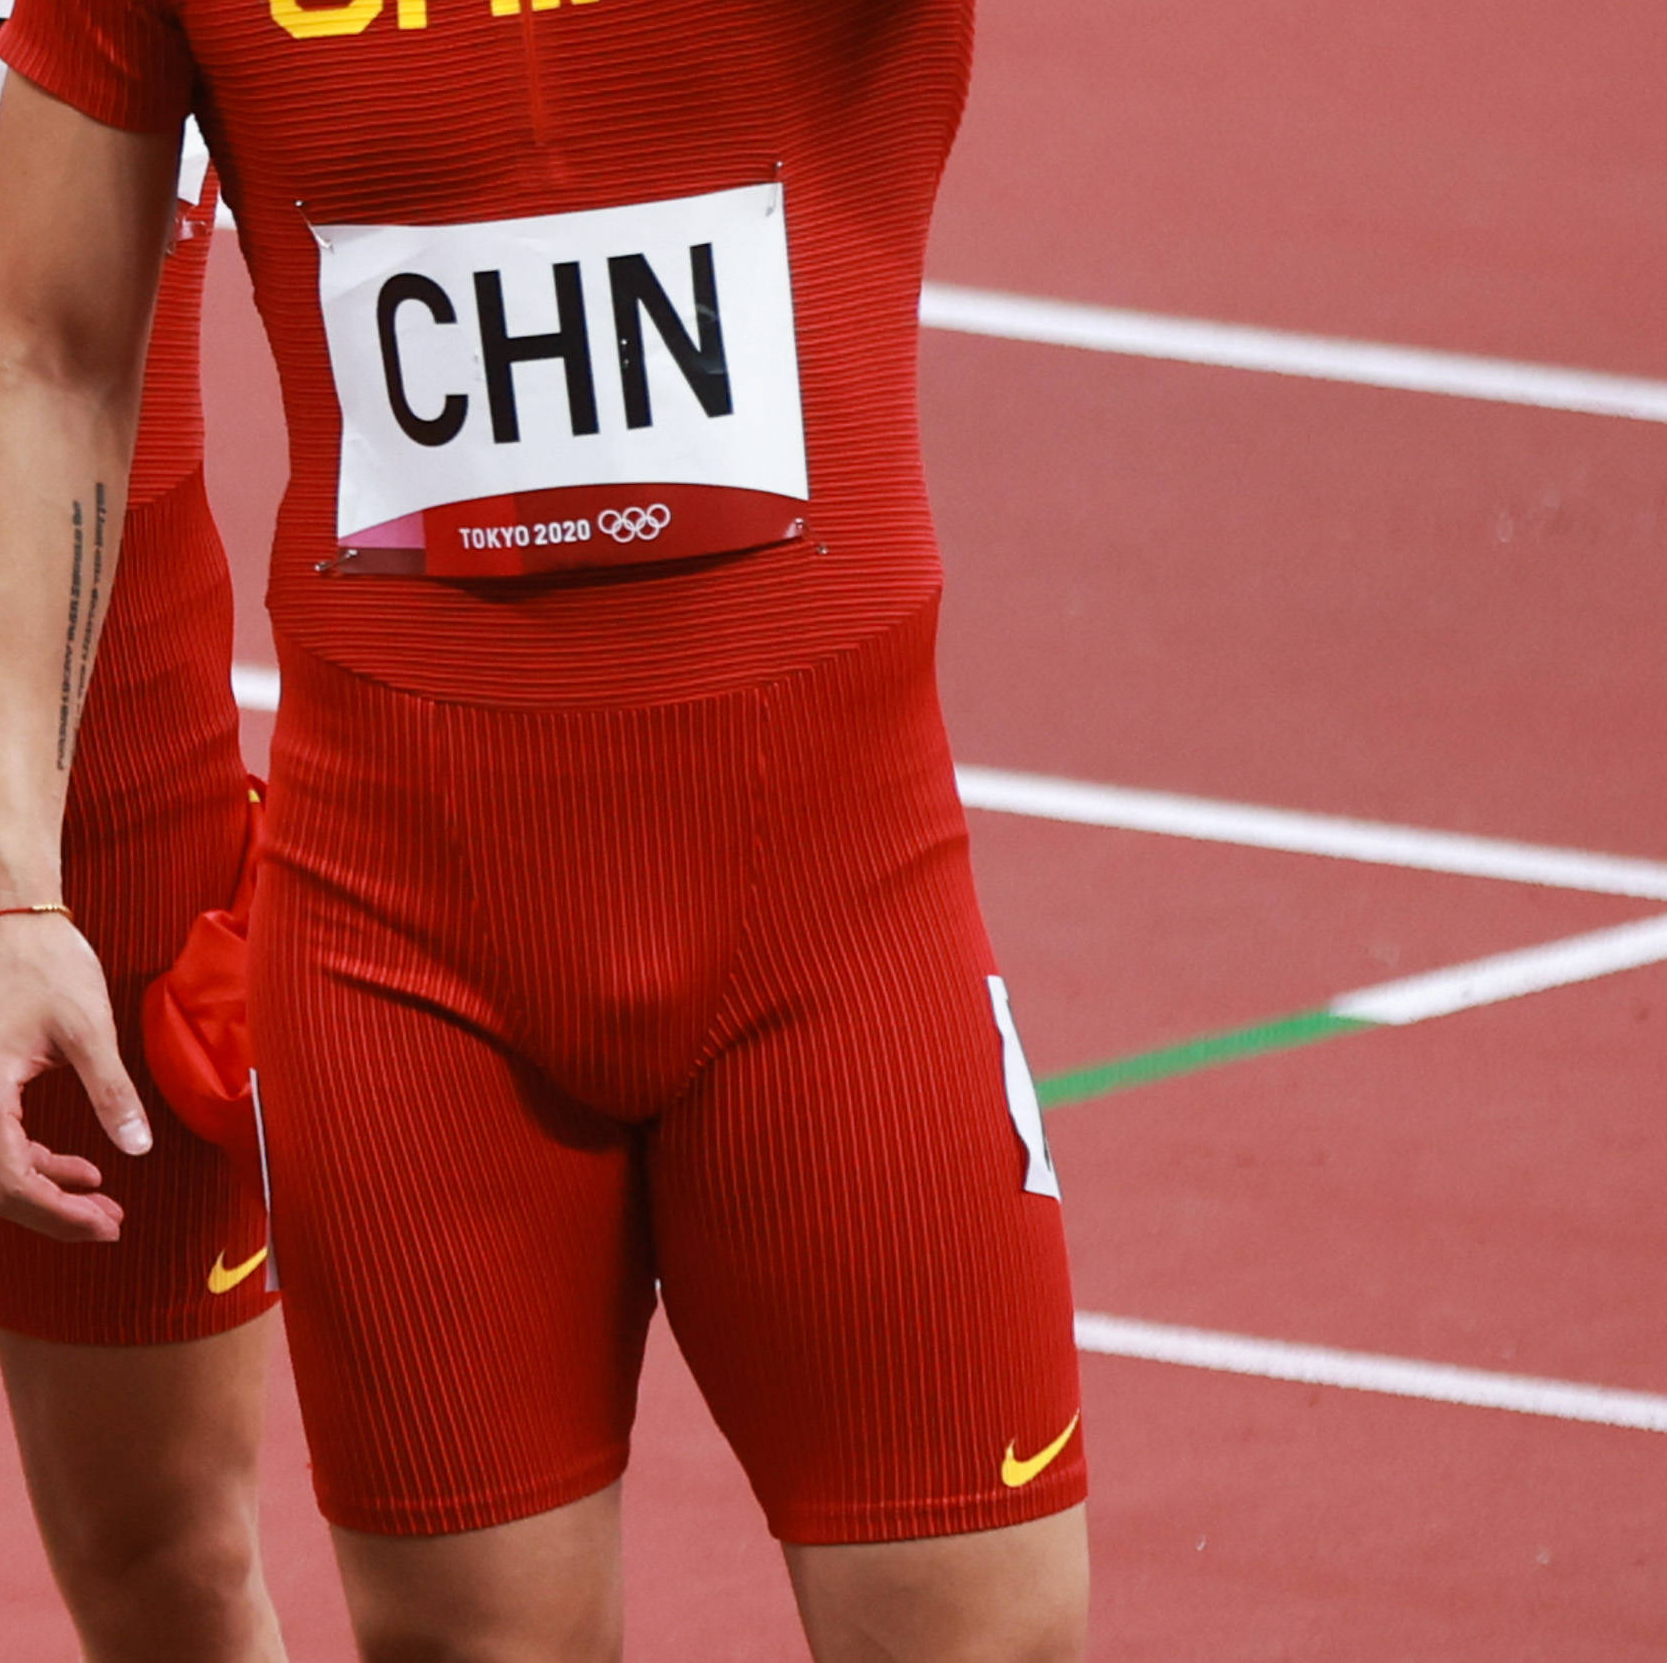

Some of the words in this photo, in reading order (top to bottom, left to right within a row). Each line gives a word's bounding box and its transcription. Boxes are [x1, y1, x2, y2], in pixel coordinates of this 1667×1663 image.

[376, 242, 732, 447] CHN
[458, 525, 531, 550] TOKYO
[533, 519, 591, 546] 2020
